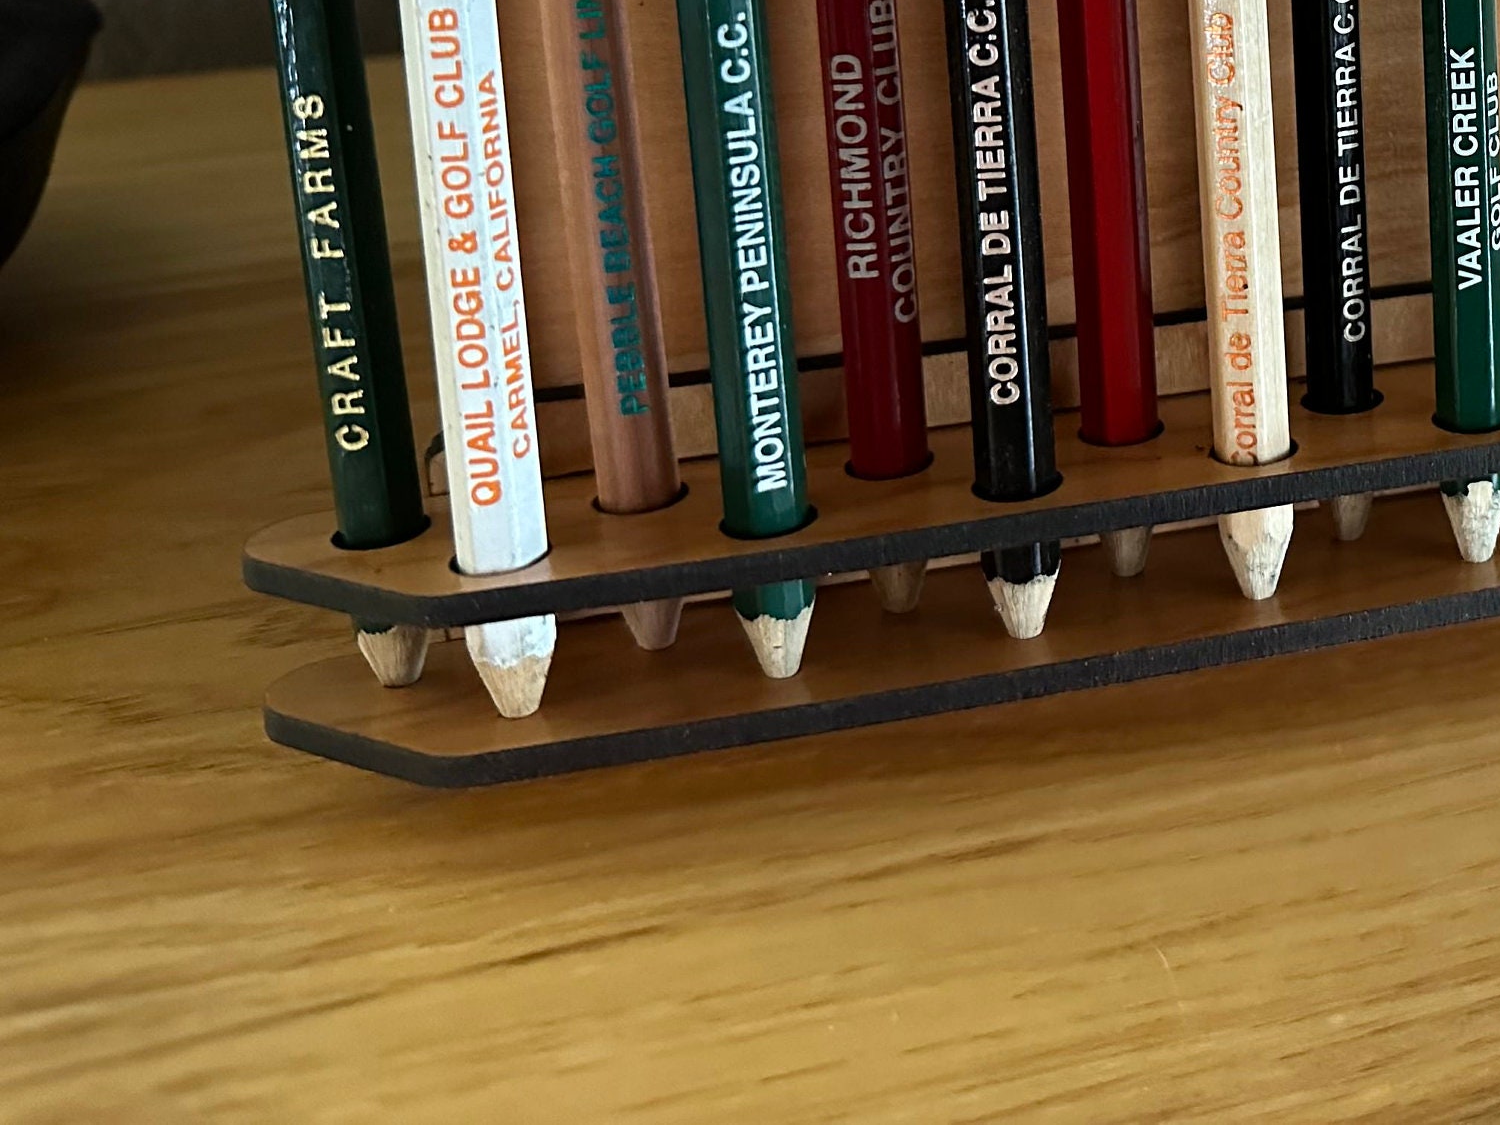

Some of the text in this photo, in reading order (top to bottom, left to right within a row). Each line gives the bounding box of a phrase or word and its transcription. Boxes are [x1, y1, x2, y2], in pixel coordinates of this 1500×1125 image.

[580, 49, 618, 146] GOLF
[1205, 11, 1237, 87] Club
[1334, 41, 1360, 158] TIERRA
[831, 54, 880, 280] RICHMOND
[972, 75, 1008, 202] TIERRA
[1212, 94, 1244, 221] Country
[1449, 46, 1484, 291] VAALER CREEK
[1486, 71, 1500, 158] CLUB
[591, 154, 632, 274] BEACH
[878, 125, 918, 324] COUNTRY
[980, 209, 1012, 256] DE
[1338, 164, 1362, 203] DE
[293, 93, 370, 453] CRAFT FARMS
[428, 7, 502, 508] QUAIL LODGE & GOLF CLUB
[478, 70, 532, 460] CARMEL, CALIFORNIA
[716, 12, 789, 494] MONTEREY PENINSULA C.C.
[1220, 229, 1250, 322] Tierra
[1341, 214, 1366, 342] CORRAL
[605, 281, 649, 417] PEBBLE
[983, 264, 1021, 406] CORRAL
[1223, 329, 1253, 373] de
